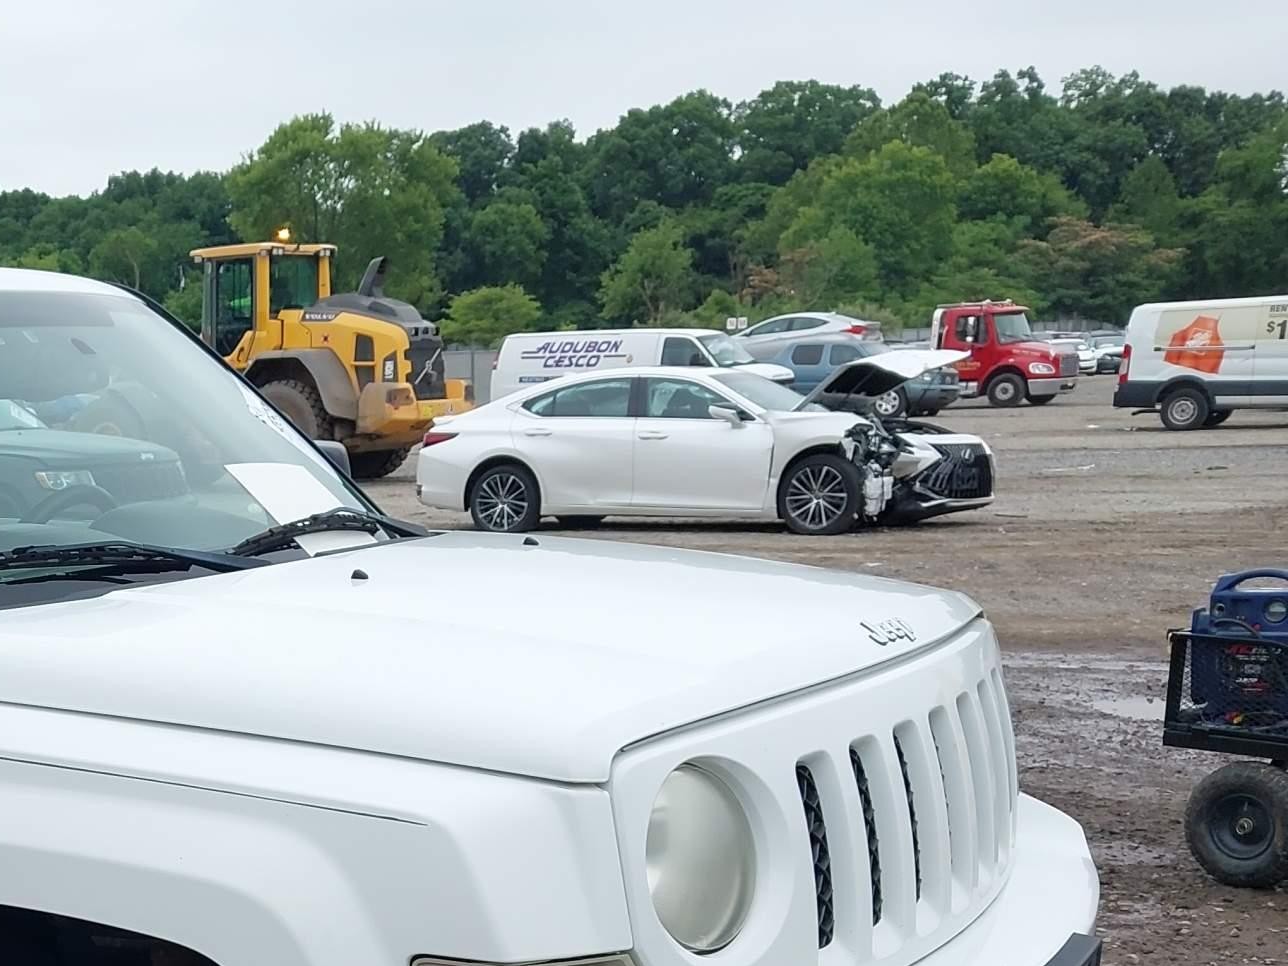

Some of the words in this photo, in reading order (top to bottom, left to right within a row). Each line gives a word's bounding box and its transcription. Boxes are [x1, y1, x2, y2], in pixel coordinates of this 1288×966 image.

[1269, 304, 1288, 312] REN
[537, 340, 623, 354] AUDUBON
[543, 355, 601, 368] CESCO
[859, 617, 917, 646] Jeep
